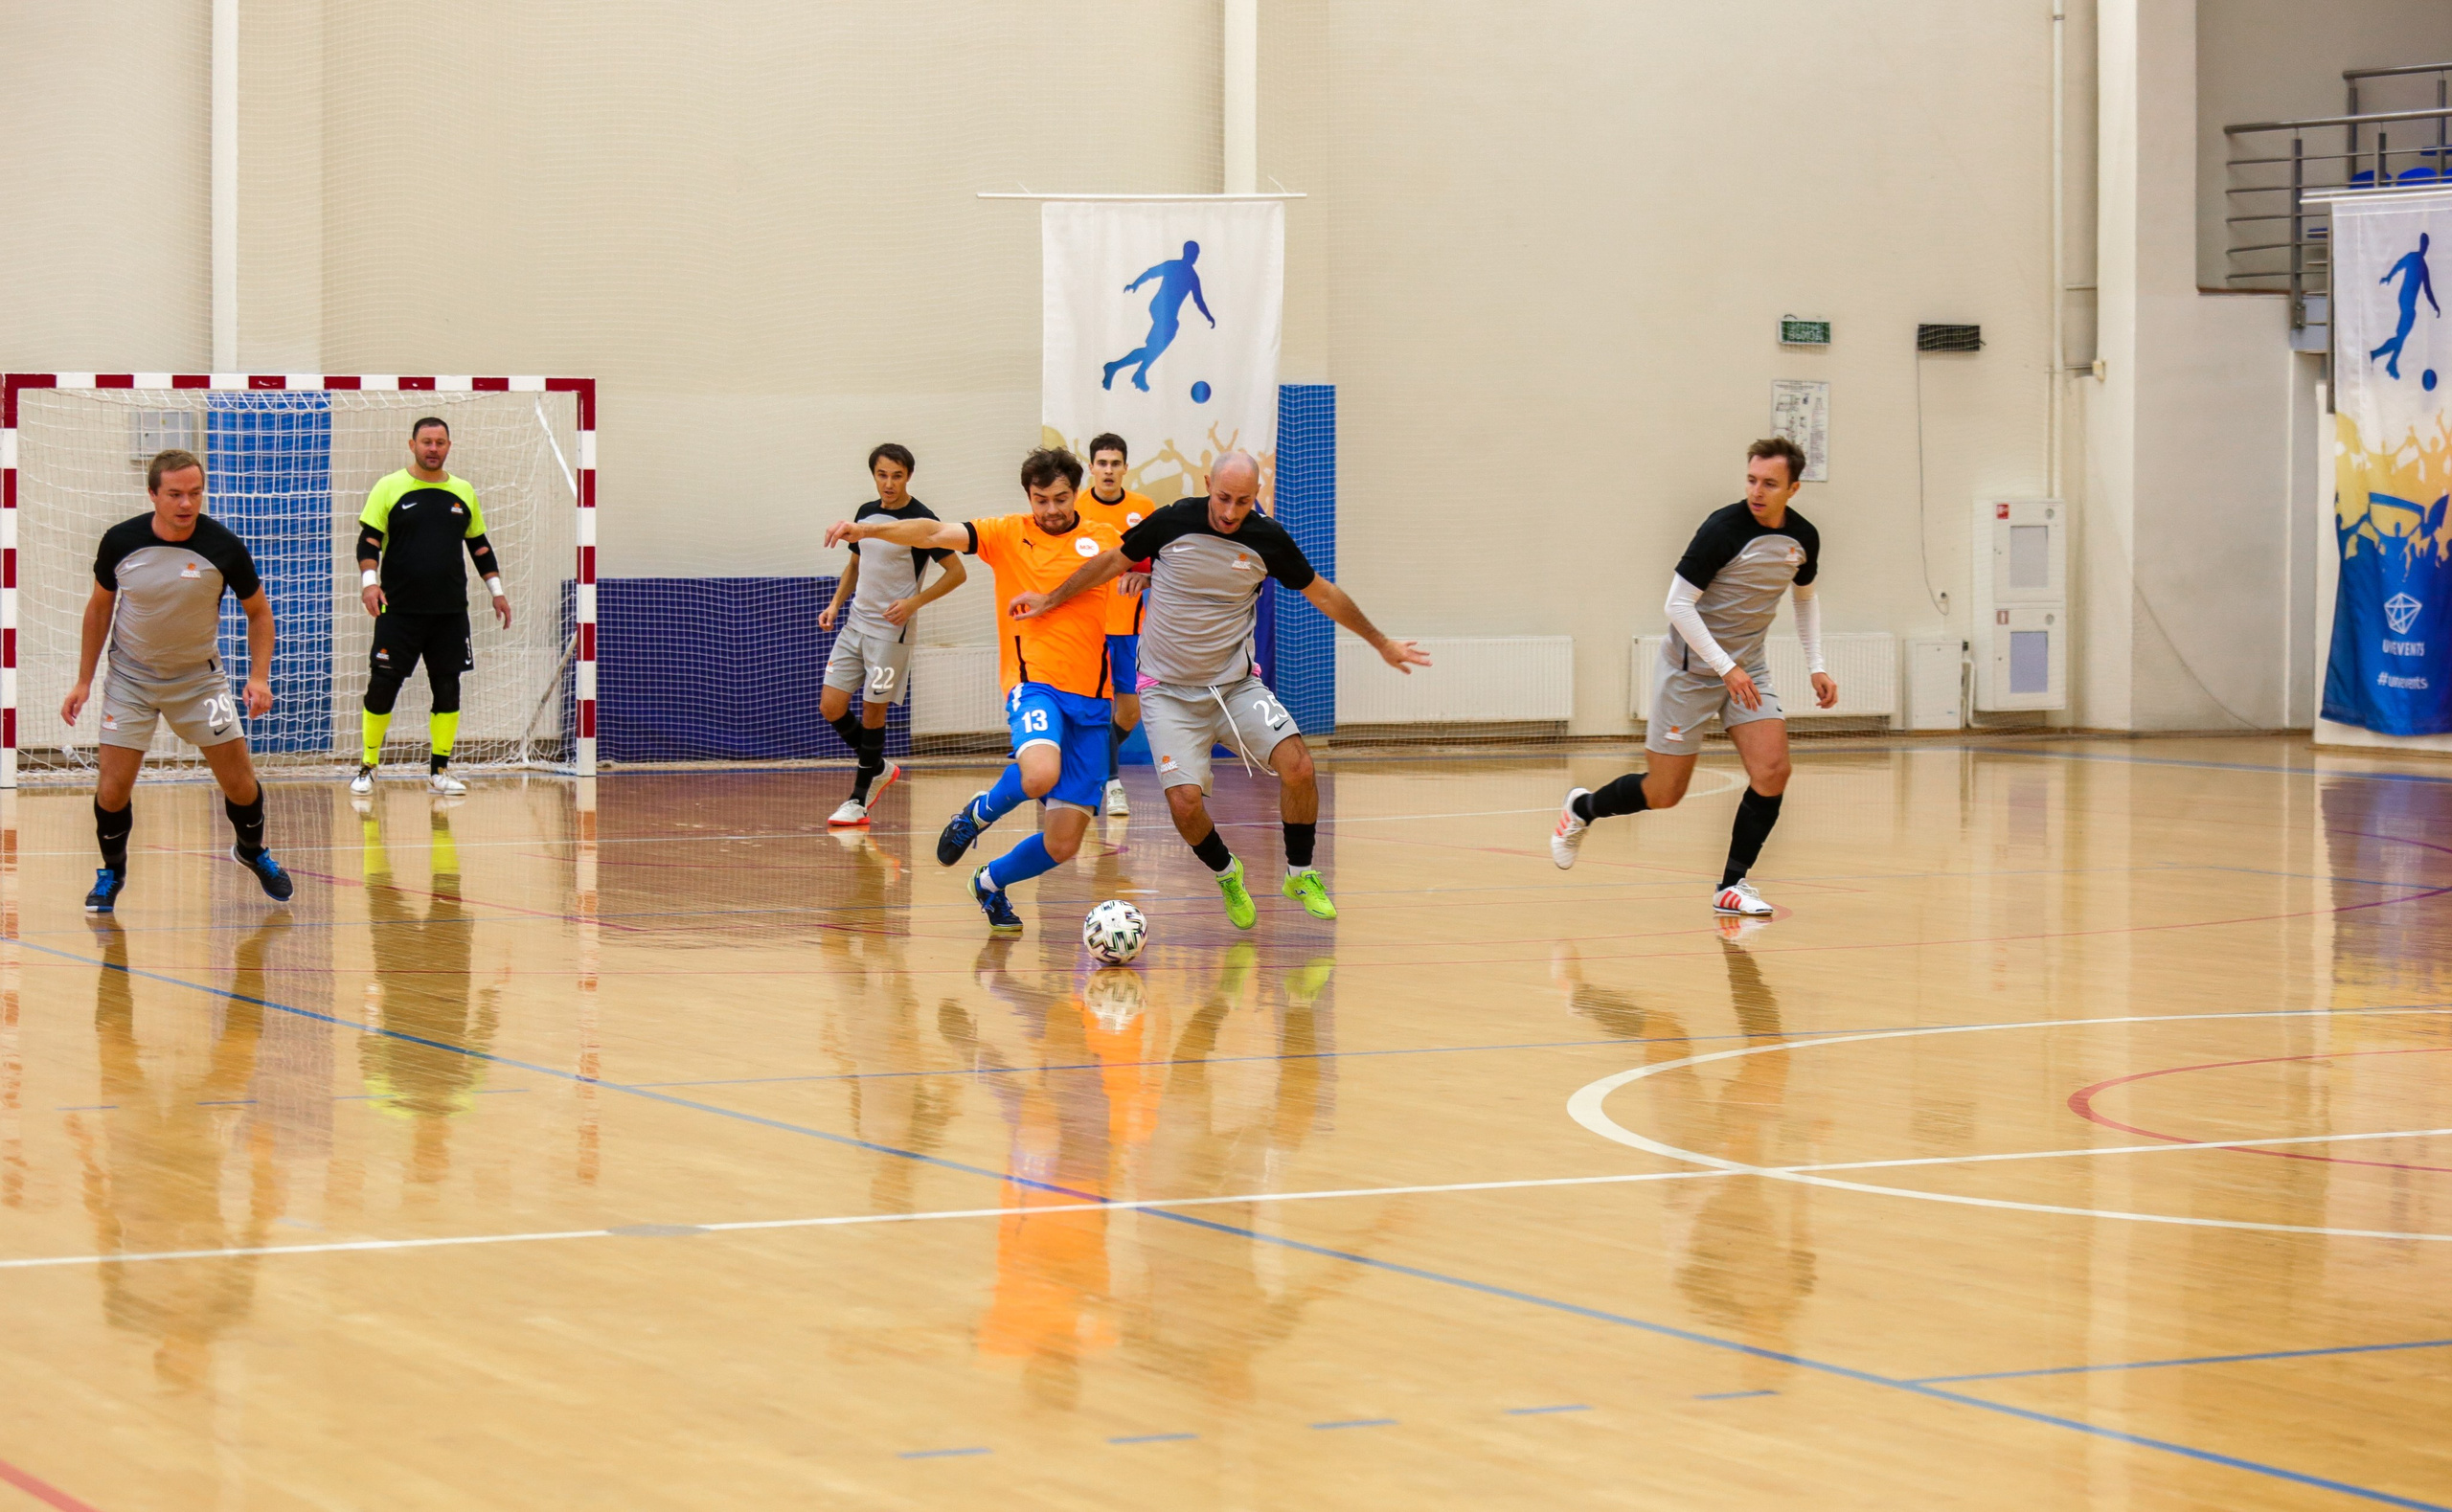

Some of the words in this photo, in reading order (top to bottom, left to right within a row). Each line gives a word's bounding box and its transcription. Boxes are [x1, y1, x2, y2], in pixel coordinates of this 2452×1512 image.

[872, 666, 896, 689] 22
[203, 692, 234, 728] 29
[1021, 709, 1049, 733] 13
[1252, 693, 1289, 727] 25
